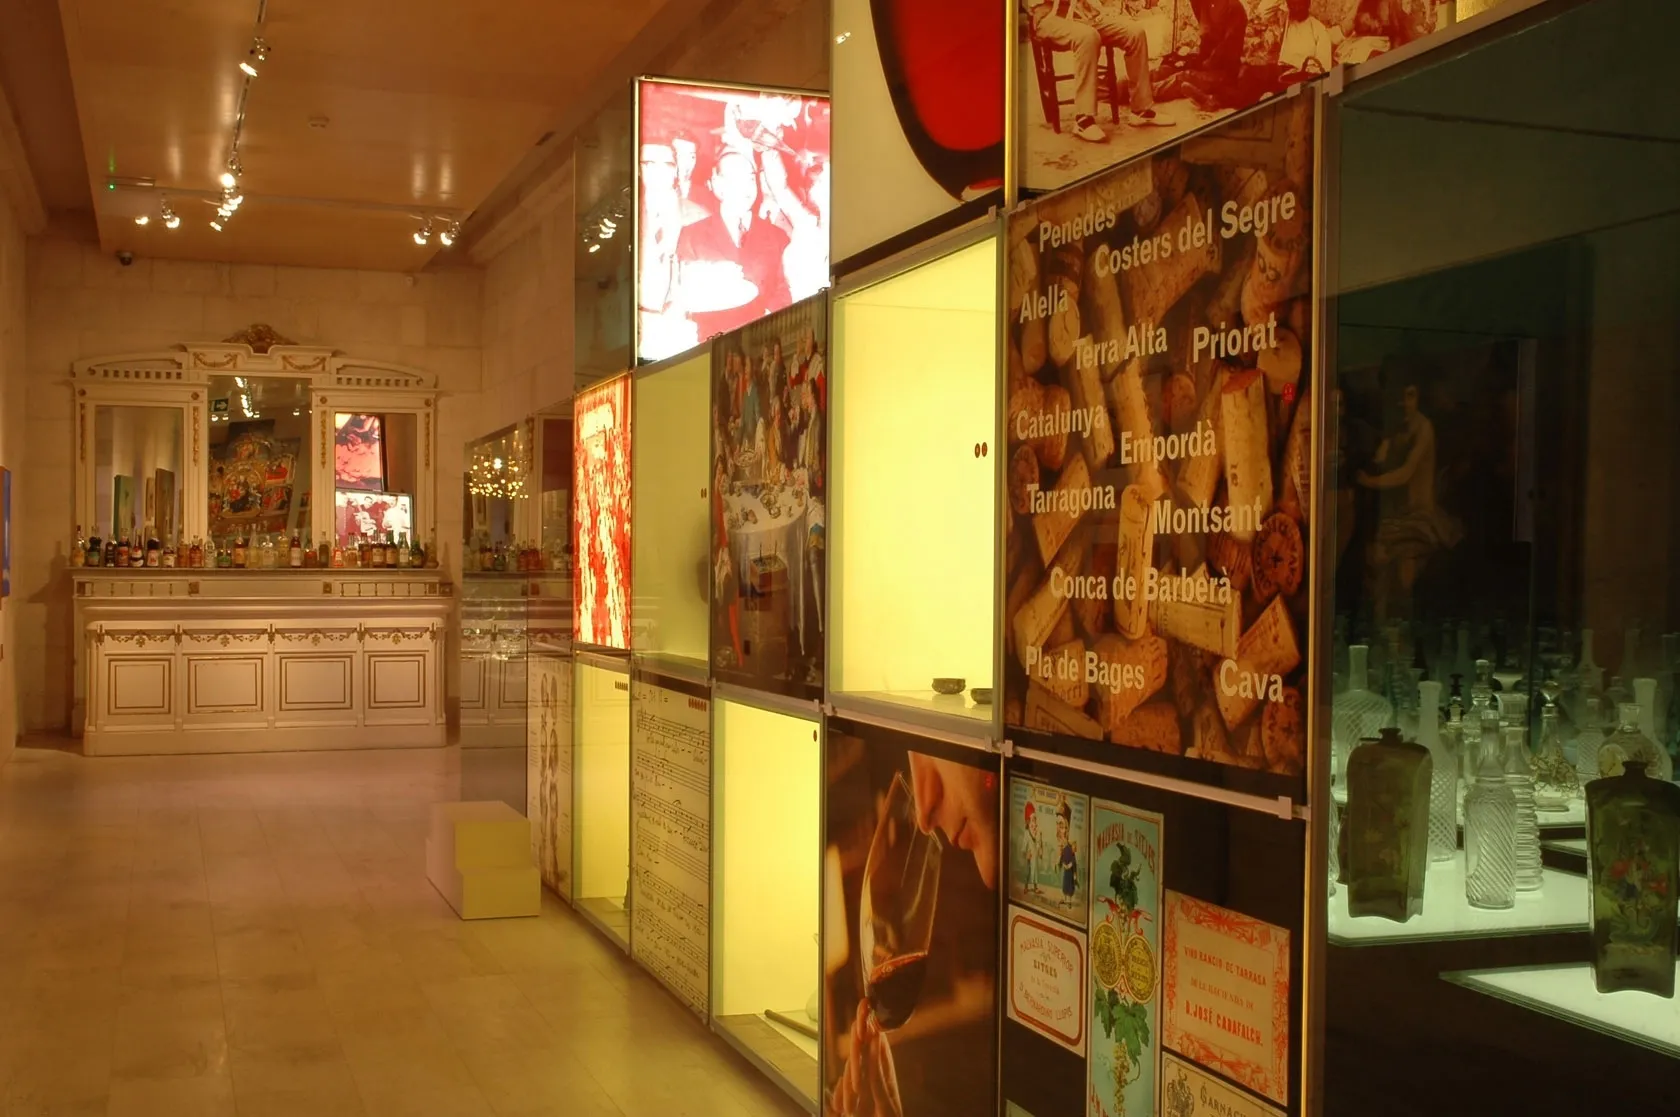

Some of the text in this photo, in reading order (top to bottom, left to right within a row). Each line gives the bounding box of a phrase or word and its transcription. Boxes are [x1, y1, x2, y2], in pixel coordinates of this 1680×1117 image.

[1039, 204, 1116, 252] Penedès
[1095, 191, 1295, 278] Costers del Segre
[1019, 283, 1068, 324] Alella
[1072, 324, 1168, 370] Terra Alta
[1193, 312, 1277, 363] Priorat
[1016, 404, 1105, 440] Catalunya
[1121, 419, 1216, 468] Empordà
[1027, 484, 1115, 519] Tarragona
[1153, 495, 1262, 535] Montsant
[1050, 566, 1232, 604] Conca de Barberà
[1025, 646, 1145, 694] Pla de Bages
[1220, 659, 1284, 702] Cava
